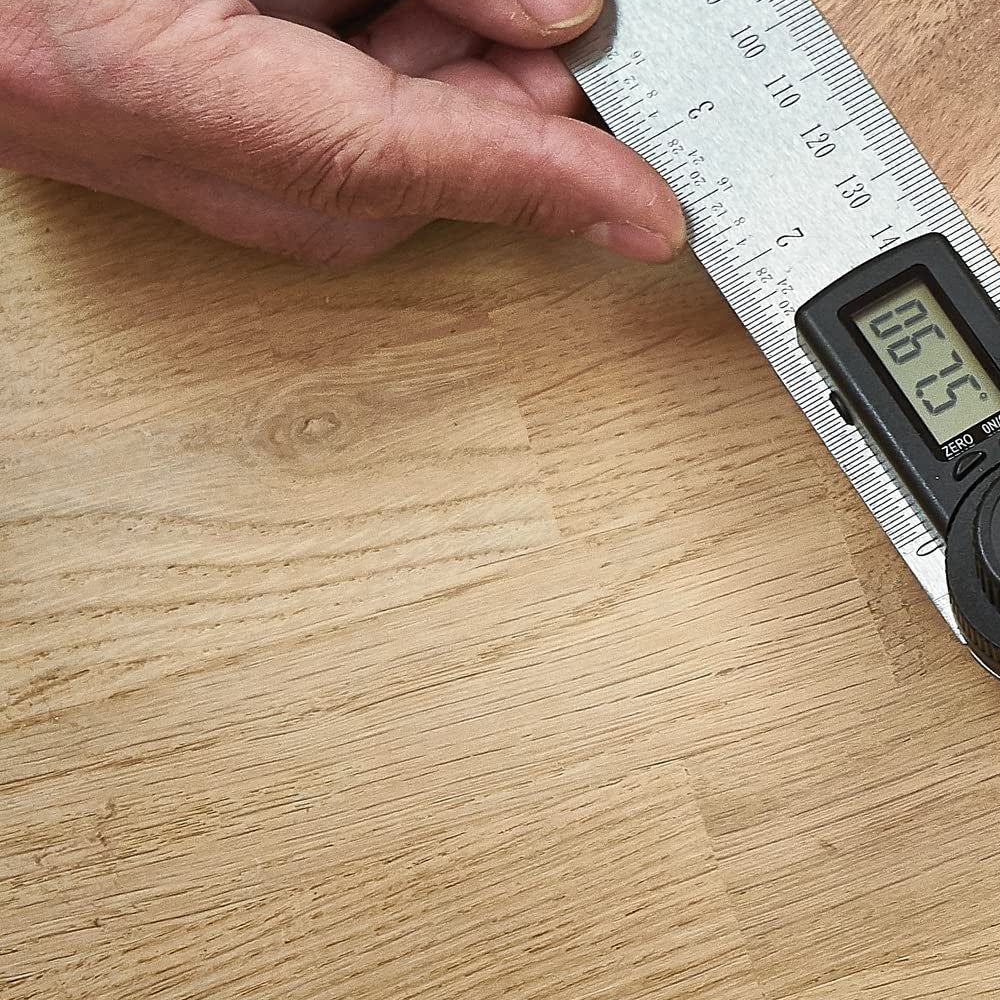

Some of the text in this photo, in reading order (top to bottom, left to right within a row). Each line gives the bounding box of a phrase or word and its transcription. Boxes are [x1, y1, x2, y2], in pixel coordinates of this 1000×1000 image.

[646, 90, 658, 98] 8
[688, 100, 714, 120] 3
[730, 25, 766, 59] 100
[764, 74, 801, 109] 110
[799, 123, 836, 158] 120
[835, 174, 872, 209] 130
[870, 225, 900, 250] 14
[667, 138, 684, 155] 28
[689, 170, 706, 187] 20
[717, 176, 733, 191] 16
[711, 202, 727, 217] 12
[733, 216, 746, 227] 8
[776, 227, 804, 247] 2
[755, 267, 773, 284] 28
[776, 278, 794, 295] 24
[779, 300, 795, 316] 20
[941, 433, 974, 458] ZERO
